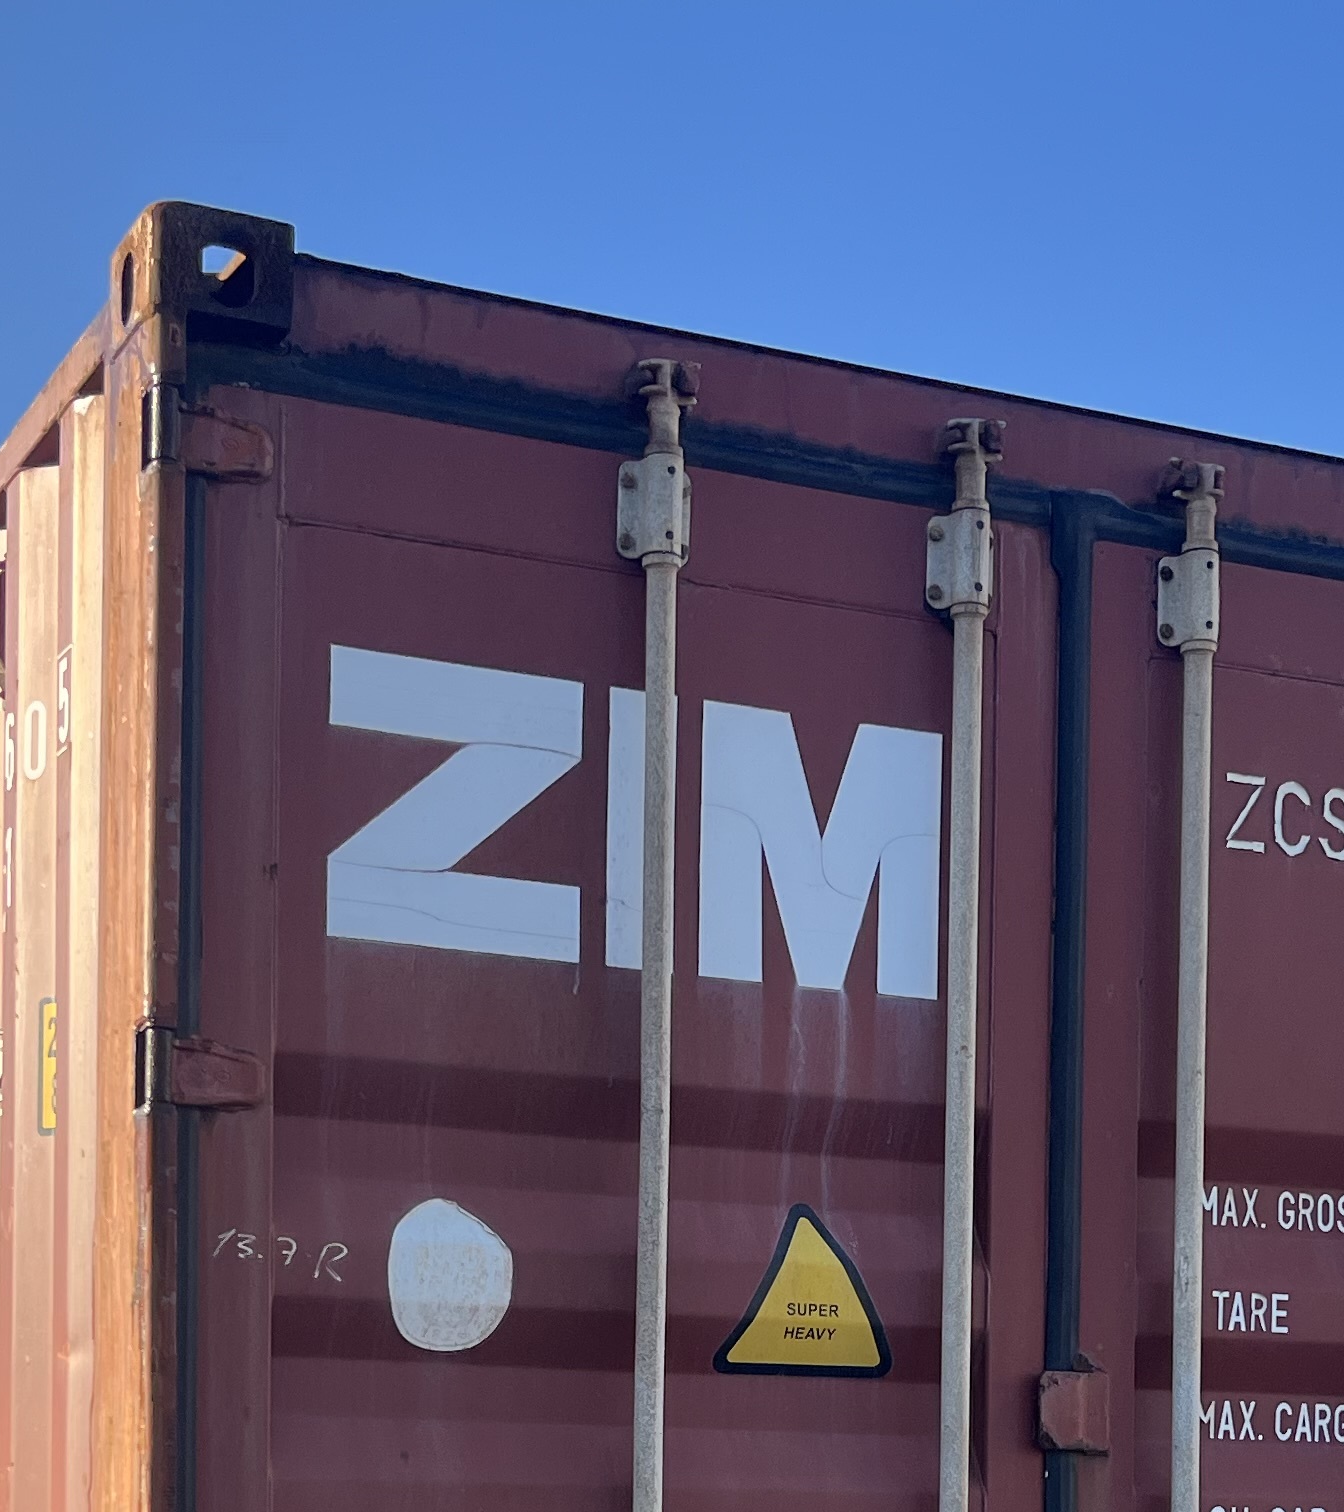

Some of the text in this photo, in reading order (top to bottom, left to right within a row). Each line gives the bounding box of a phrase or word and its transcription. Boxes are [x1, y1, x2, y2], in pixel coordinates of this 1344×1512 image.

[327, 644, 943, 1000] ZIM
[1202, 1185, 1267, 1230] MAX.
[786, 1302, 840, 1318] SUPER
[1211, 1290, 1289, 1334] TARE
[783, 1326, 837, 1341] HEAVY
[1199, 1400, 1264, 1441] MAX.
